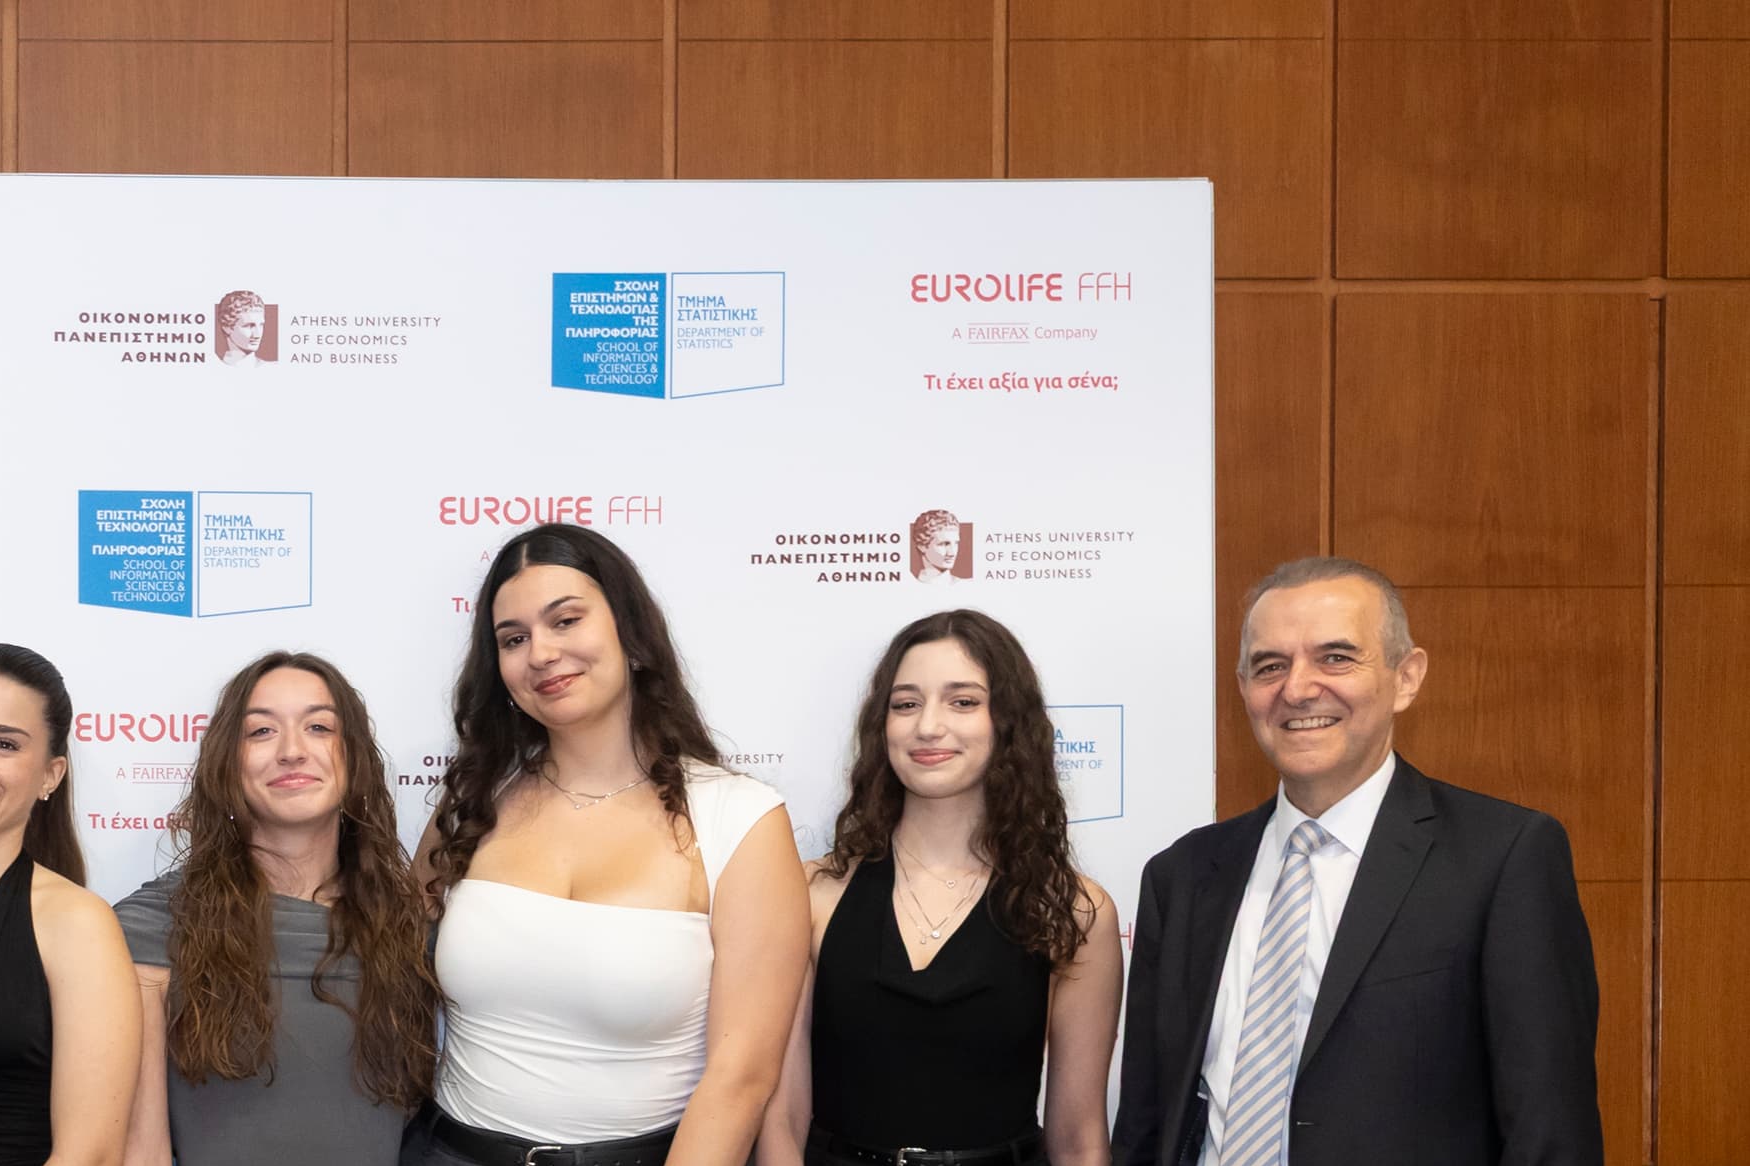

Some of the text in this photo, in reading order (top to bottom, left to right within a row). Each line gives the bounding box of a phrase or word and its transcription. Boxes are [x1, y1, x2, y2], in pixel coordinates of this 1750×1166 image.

[615, 281, 658, 291] ΣΧΟΛΗ
[911, 272, 1131, 302] EUROLIFE FFH
[570, 293, 646, 303] ΕΠΙΣΤΗΜΩΝ
[677, 296, 725, 308] ΤΜΗΜΑ
[570, 305, 658, 314] ΤΕΧΝΟΛΟΓΙΑΣ
[677, 309, 758, 320] ΣΤΑΤΙΣΤΙΚΗΣ
[79, 312, 206, 324] ΟΙΚΟΝΟΜΙΚΟ
[291, 316, 441, 327] ATHENS UNIVERSITY
[633, 316, 658, 326] ΤΗΣ
[54, 332, 206, 344] ΠΑΝΕΠΙΣΤΗΜΙΟ
[566, 328, 658, 338] ΠΛΗΡΟΦΟΡΙΑΣ
[677, 327, 765, 338] DEPARTMENT OF
[952, 327, 1097, 340] A FAIRFAX Company
[291, 334, 407, 345] OF ECONOMICS
[677, 339, 733, 348] STATISTICS
[597, 343, 658, 352] SCHOOL OF
[121, 352, 206, 363] ΑΘΗΝΩΝ
[291, 354, 398, 364] AND BUSINESS
[583, 353, 658, 362] INFORMATION
[599, 364, 647, 373] SCIENCES
[585, 375, 658, 384] TECHNOLOGY
[924, 371, 1118, 392] Τι έχει αξία για σένα;
[141, 499, 185, 509] ΣΧΟΛΗ
[97, 511, 172, 520] ΕΠΙΣΤΗΜΩΝ
[440, 496, 661, 524] EUROLIFE FFH
[204, 515, 253, 526] ΤΜΗΜΑ
[97, 523, 185, 532] ΤΕΧΝΟΛΟΓΙΑΣ
[159, 534, 185, 544] ΤΗΣ
[204, 529, 285, 540] ΣΤΑΤΙΣΤΙΚΗΣ
[776, 533, 901, 545] ΟΙΚΟΝΟΜΙΚΟ
[986, 531, 1134, 543] ATHENS UNIVERSITY
[93, 546, 185, 555] ΠΛΗΡΟΦΟΡΙΑΣ
[204, 547, 291, 557] DEPARTMENT OF
[752, 553, 901, 564] ΠΑΝΕΠΙΣΤΗΜΙΟ
[986, 551, 1102, 562] OF ECONOMICS
[124, 560, 185, 570] SCHOOL OF
[204, 558, 260, 568] STATISTICS
[110, 571, 185, 580] INFORMATION
[817, 572, 901, 583] ΑΘΗΝΩΝ
[986, 569, 1092, 580] AND BUSINESS
[125, 582, 174, 591] SCIENCES
[112, 592, 185, 602] TECHNOLOGY
[75, 713, 209, 742] EUROLIF
[116, 768, 125, 779] A
[89, 813, 148, 829] Τι έχει
